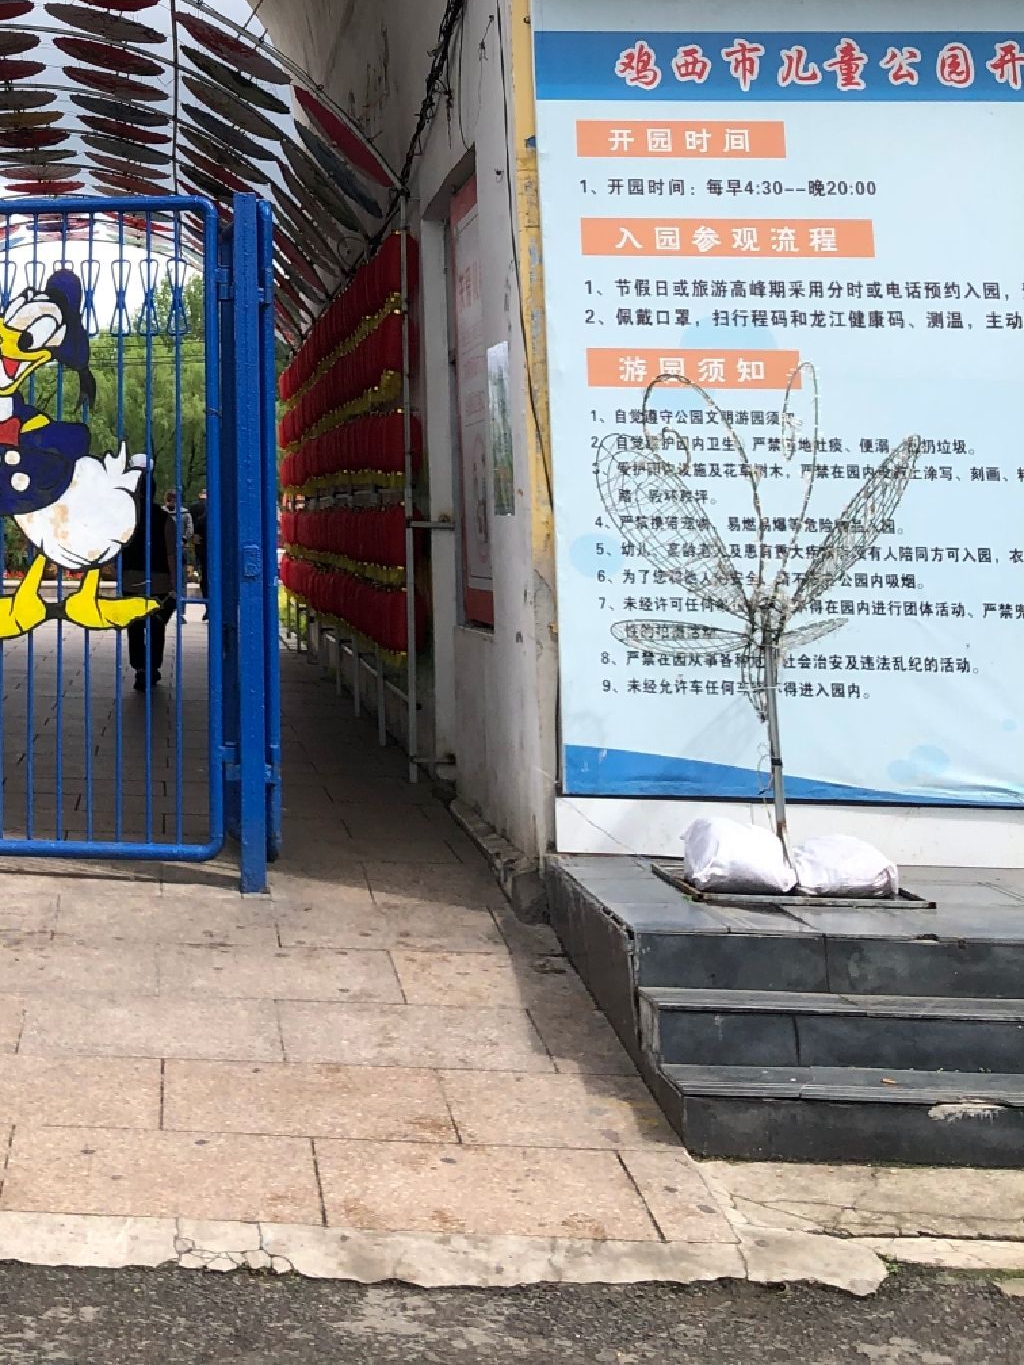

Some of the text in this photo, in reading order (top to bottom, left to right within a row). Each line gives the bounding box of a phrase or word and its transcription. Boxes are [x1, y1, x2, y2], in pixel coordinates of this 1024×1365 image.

[614, 38, 1024, 91] 鸡西市儿童公园开
[607, 128, 752, 154] 开园时间
[614, 225, 839, 254] 入园参观流程
[584, 278, 1024, 302] 1、节假日或旅游高峰期采用分时或电话预约入园，
[617, 354, 766, 382] 游园须知
